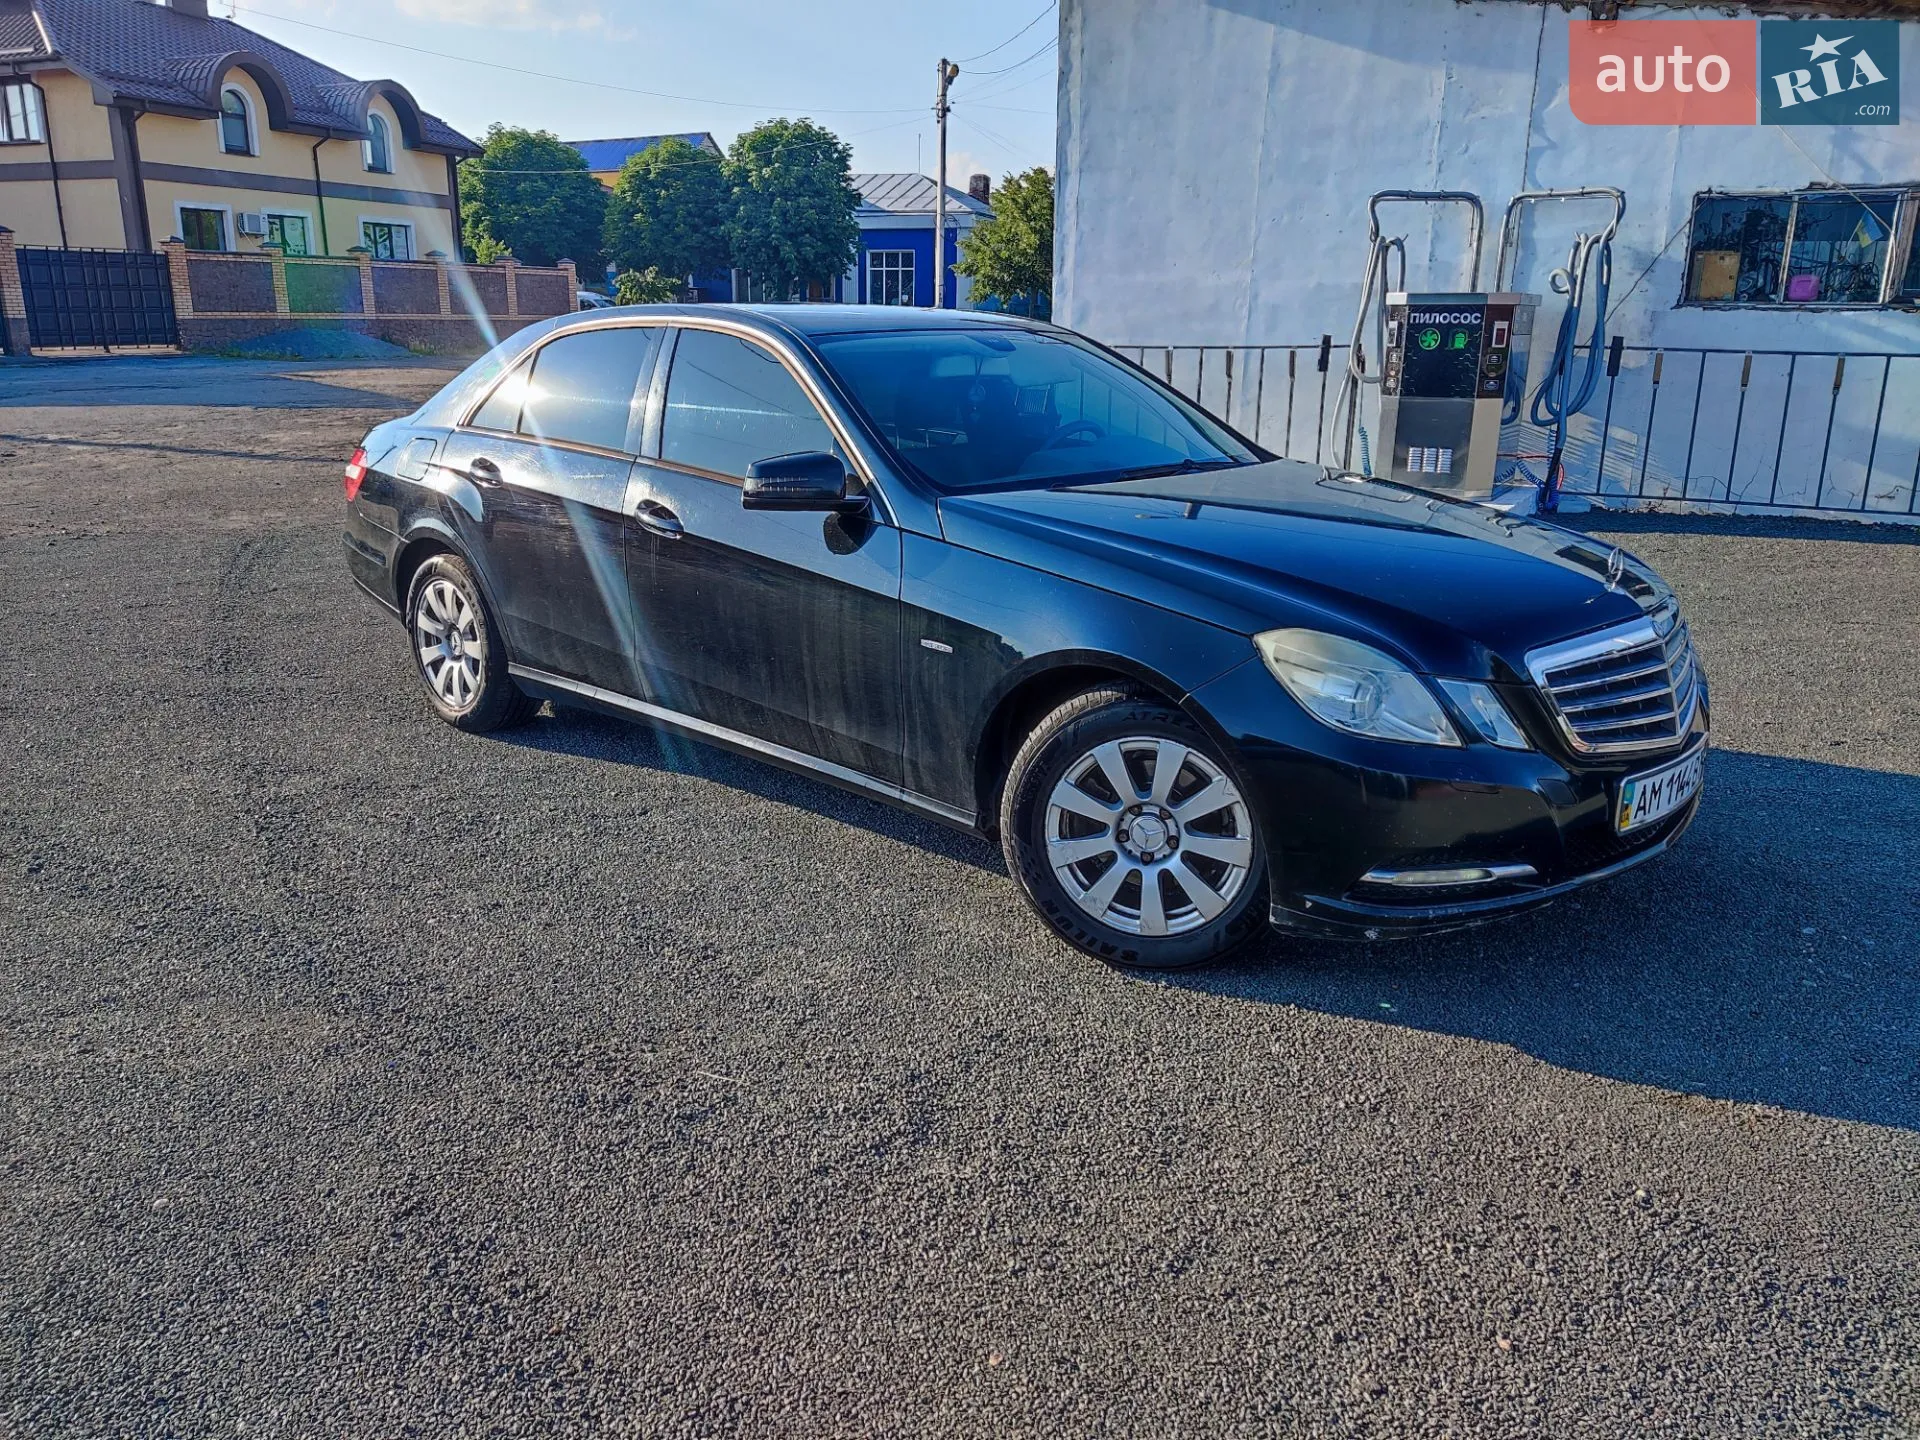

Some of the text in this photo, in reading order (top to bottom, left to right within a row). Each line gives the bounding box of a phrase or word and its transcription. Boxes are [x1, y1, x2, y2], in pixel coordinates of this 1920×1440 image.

[1409, 312, 1481, 324] ПИЛОСОС
[1633, 778, 1664, 820] AM
[1040, 899, 1140, 962] SAILUN
